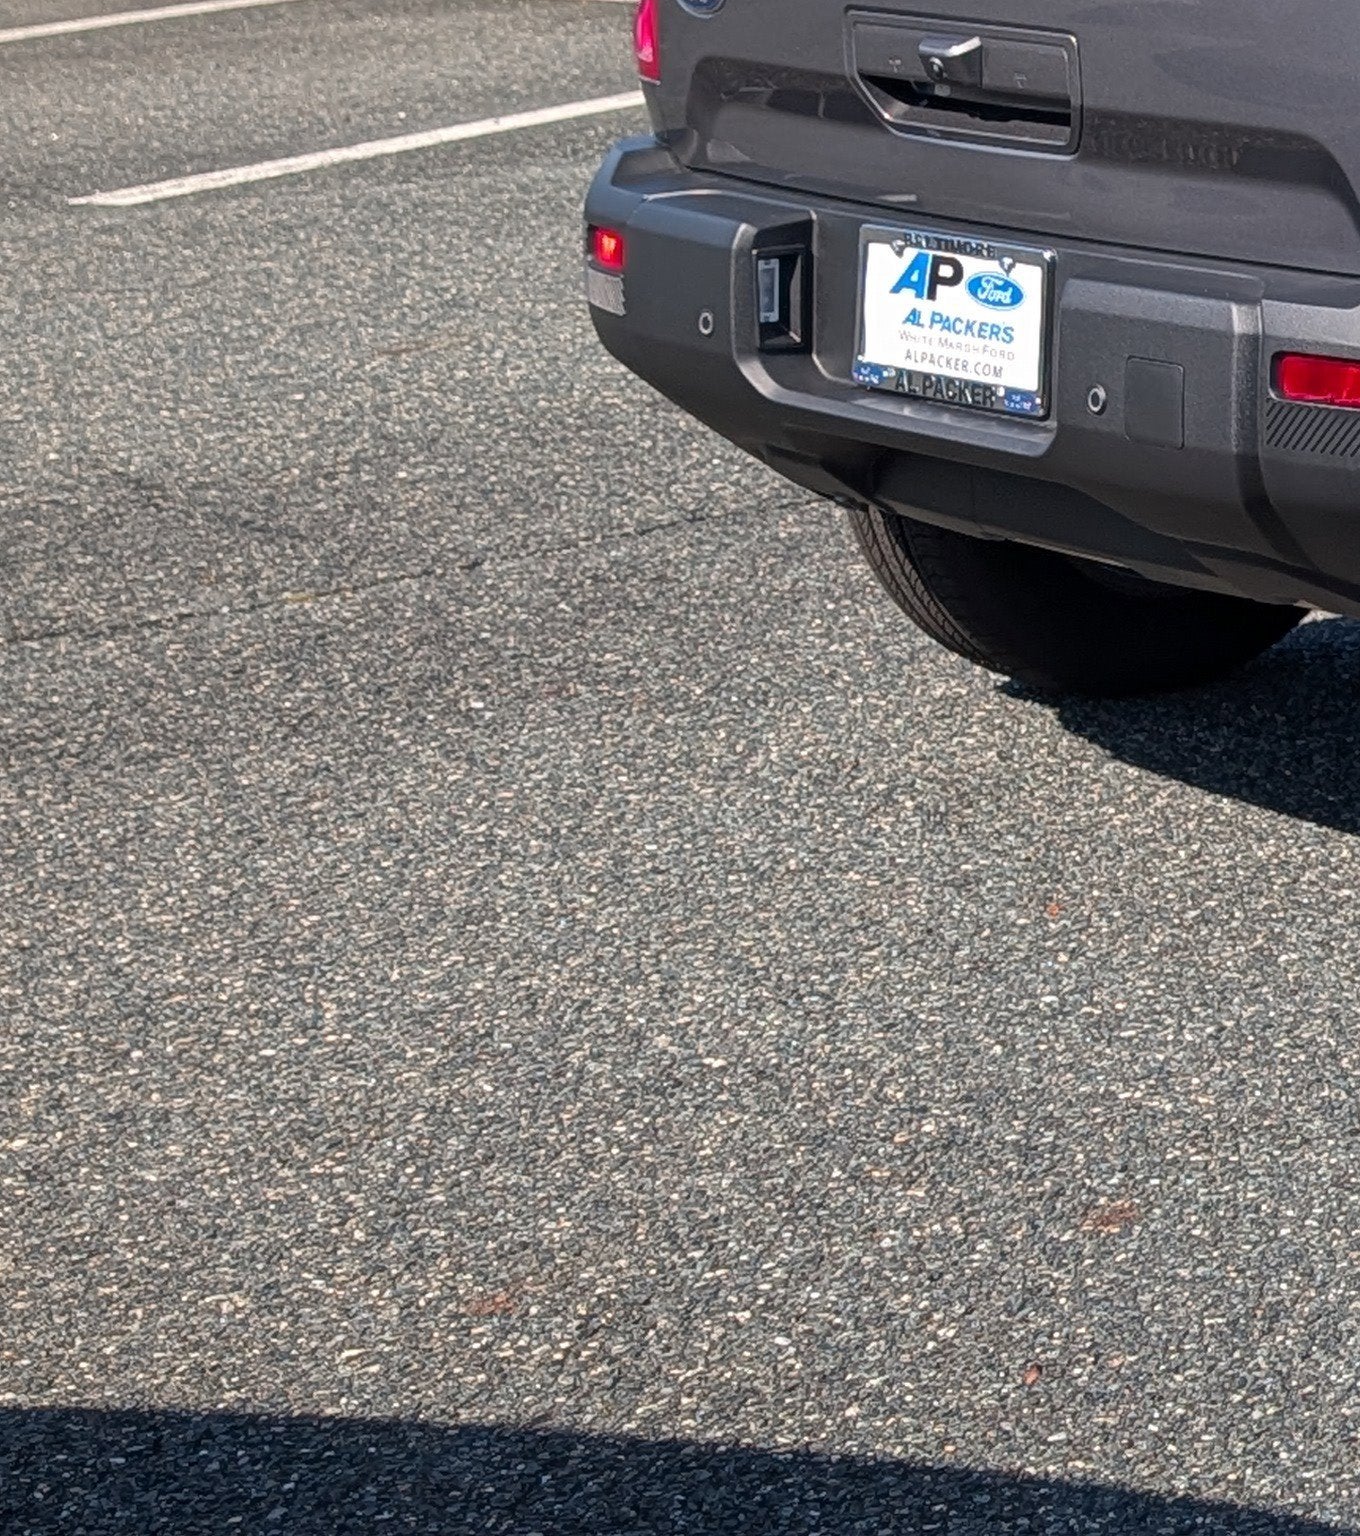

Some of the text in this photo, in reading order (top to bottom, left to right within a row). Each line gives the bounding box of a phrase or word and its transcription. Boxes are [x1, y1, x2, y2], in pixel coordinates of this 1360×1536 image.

[889, 250, 965, 302] AP
[901, 307, 925, 329] AL
[904, 348, 1004, 379] ALPACKER.COM
[895, 366, 920, 393] AL
[921, 372, 997, 408] PACKER
